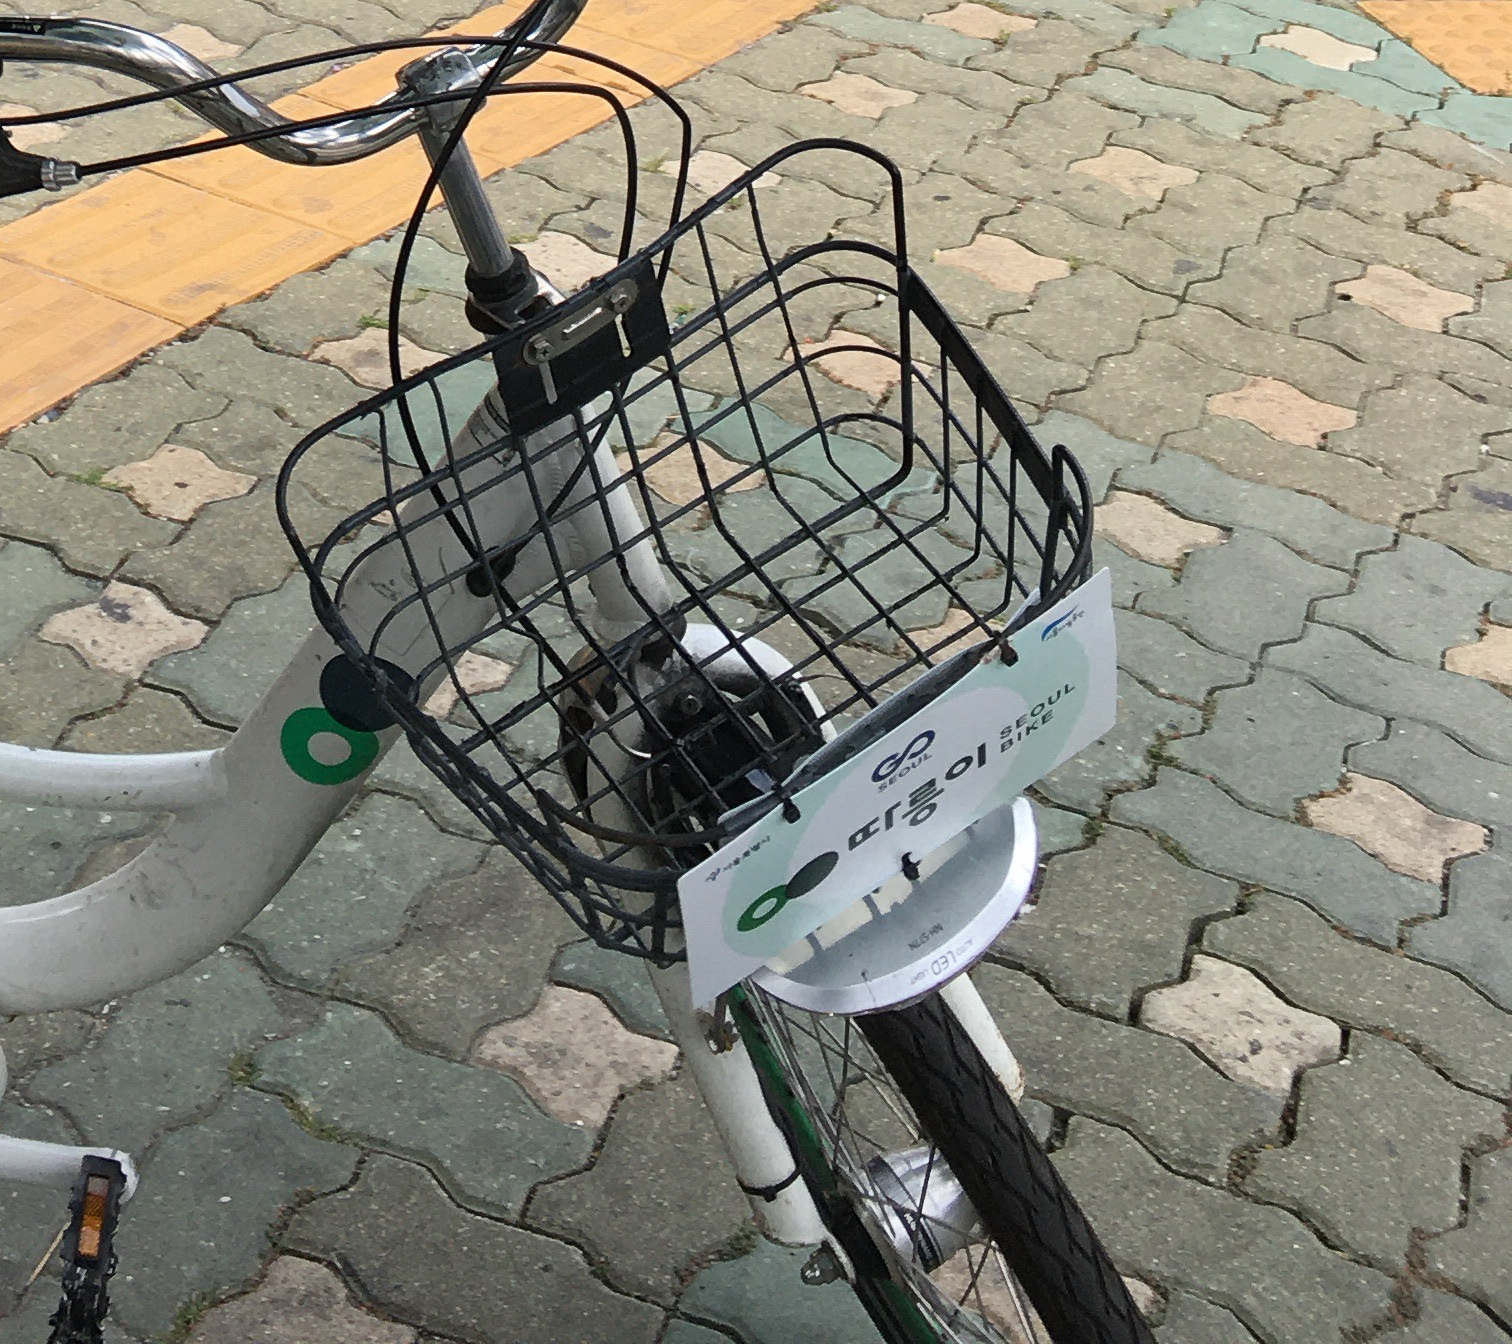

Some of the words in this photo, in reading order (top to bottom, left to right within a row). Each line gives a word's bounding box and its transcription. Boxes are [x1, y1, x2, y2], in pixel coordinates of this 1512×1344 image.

[999, 681, 1076, 741] SEOUL
[999, 708, 1055, 754] BIKE
[877, 750, 934, 794] SEOUL
[847, 741, 988, 853] 따릉이
[929, 947, 959, 977] LED
